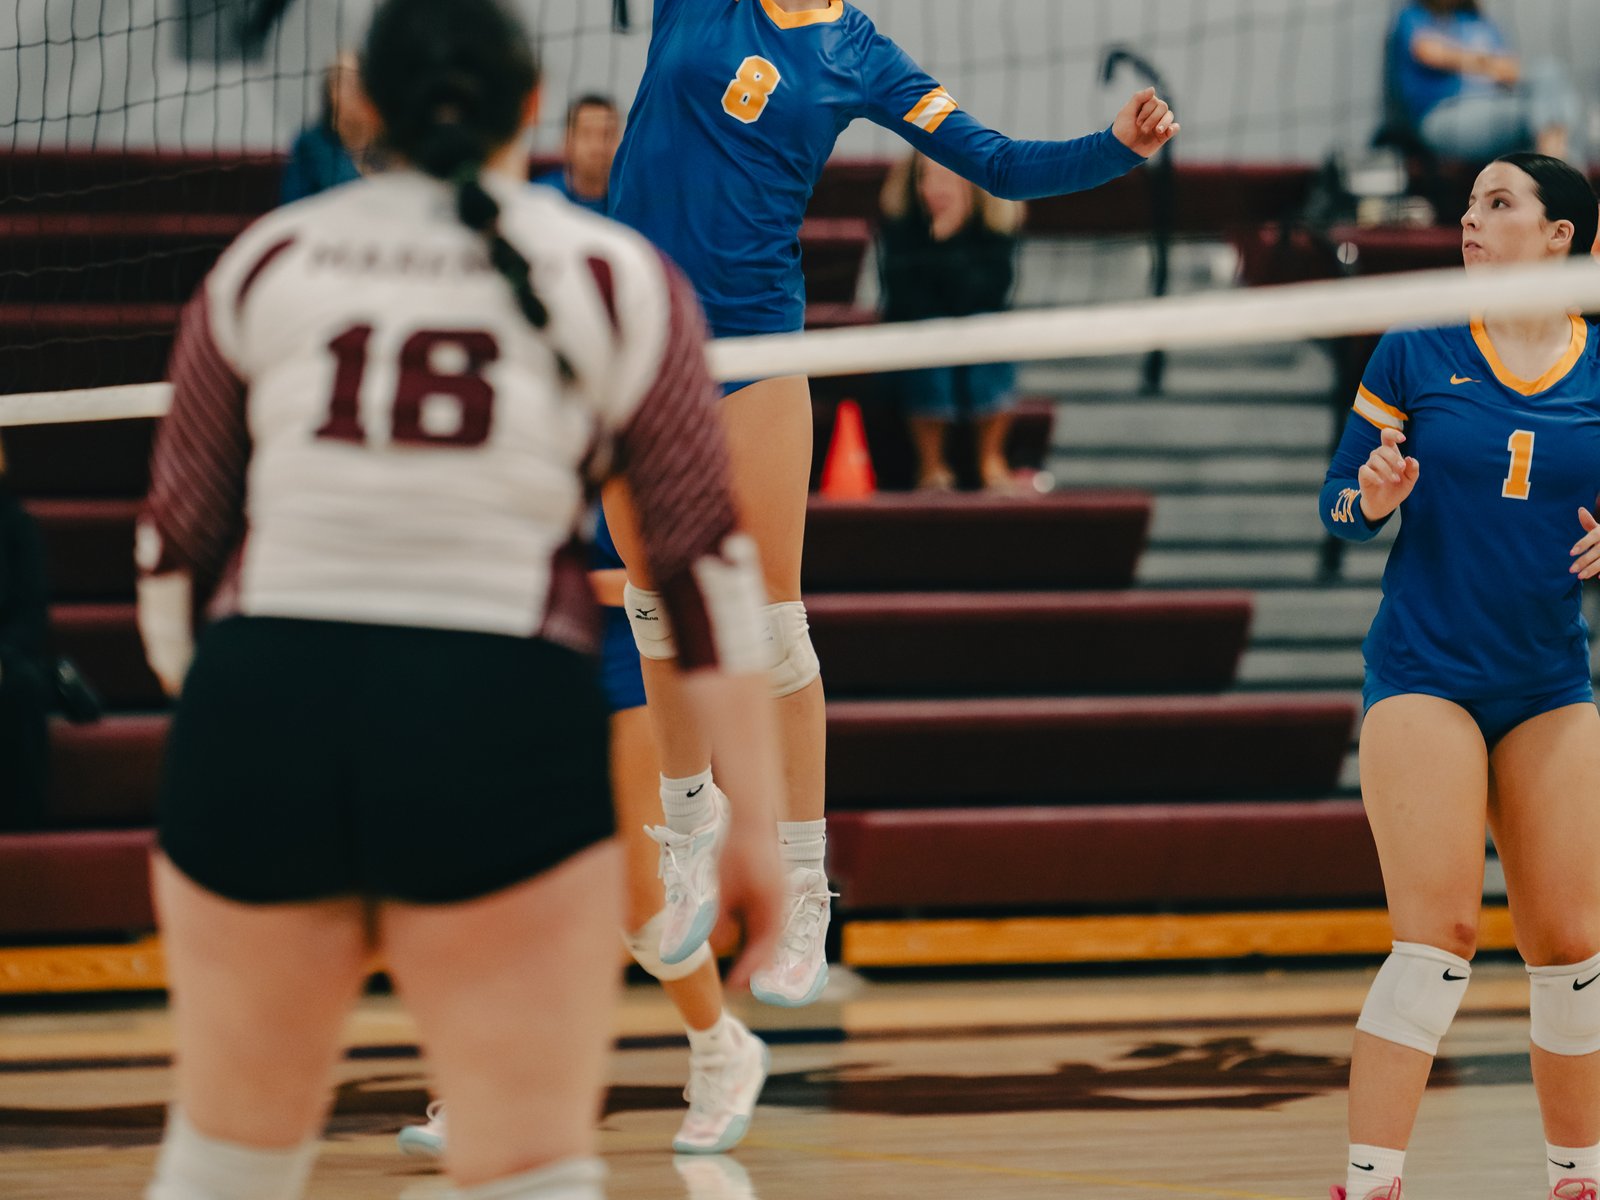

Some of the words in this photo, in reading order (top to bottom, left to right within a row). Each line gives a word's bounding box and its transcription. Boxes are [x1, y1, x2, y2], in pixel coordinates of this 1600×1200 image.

[721, 55, 781, 123] 8
[314, 323, 499, 447] 18
[1502, 429, 1535, 500] 1
